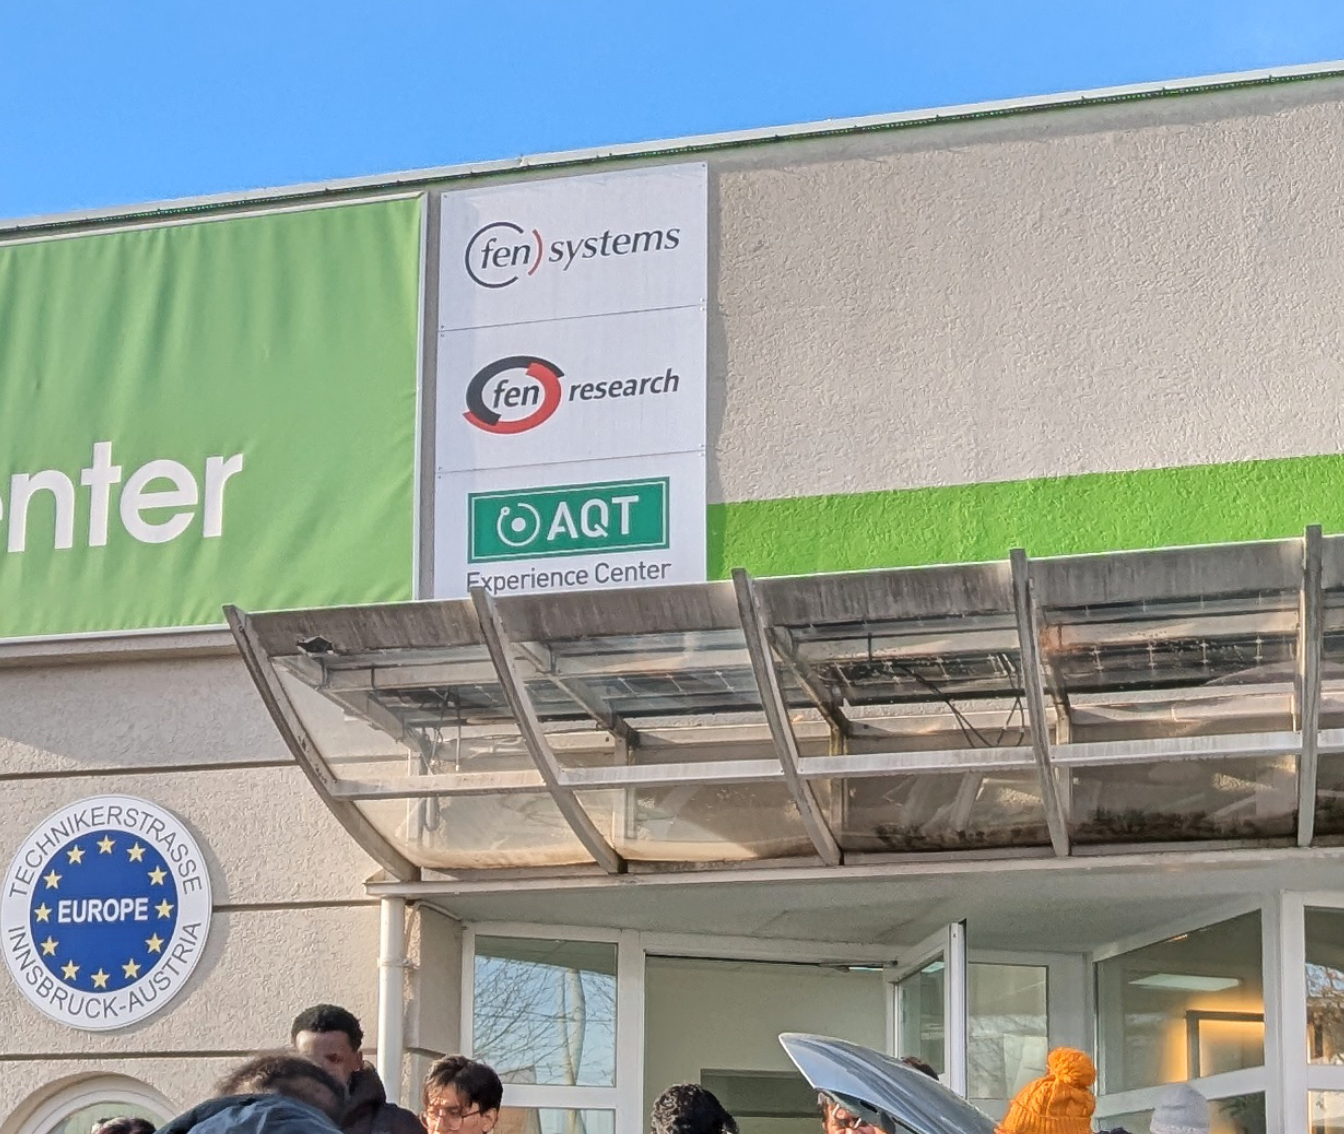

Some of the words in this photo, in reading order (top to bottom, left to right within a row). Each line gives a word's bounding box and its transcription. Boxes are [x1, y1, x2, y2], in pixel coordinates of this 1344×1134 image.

[548, 228, 681, 271] systems
[492, 379, 540, 409] fen
[568, 367, 680, 402] research
[546, 494, 640, 541] AQT
[467, 567, 588, 595] Experience
[594, 560, 672, 585] Center
[9, 805, 203, 897] TECHNIKERSTRASSE
[58, 897, 149, 923] EUROPE
[8, 921, 202, 1018] INNSBRUCK-AUSTRIA
